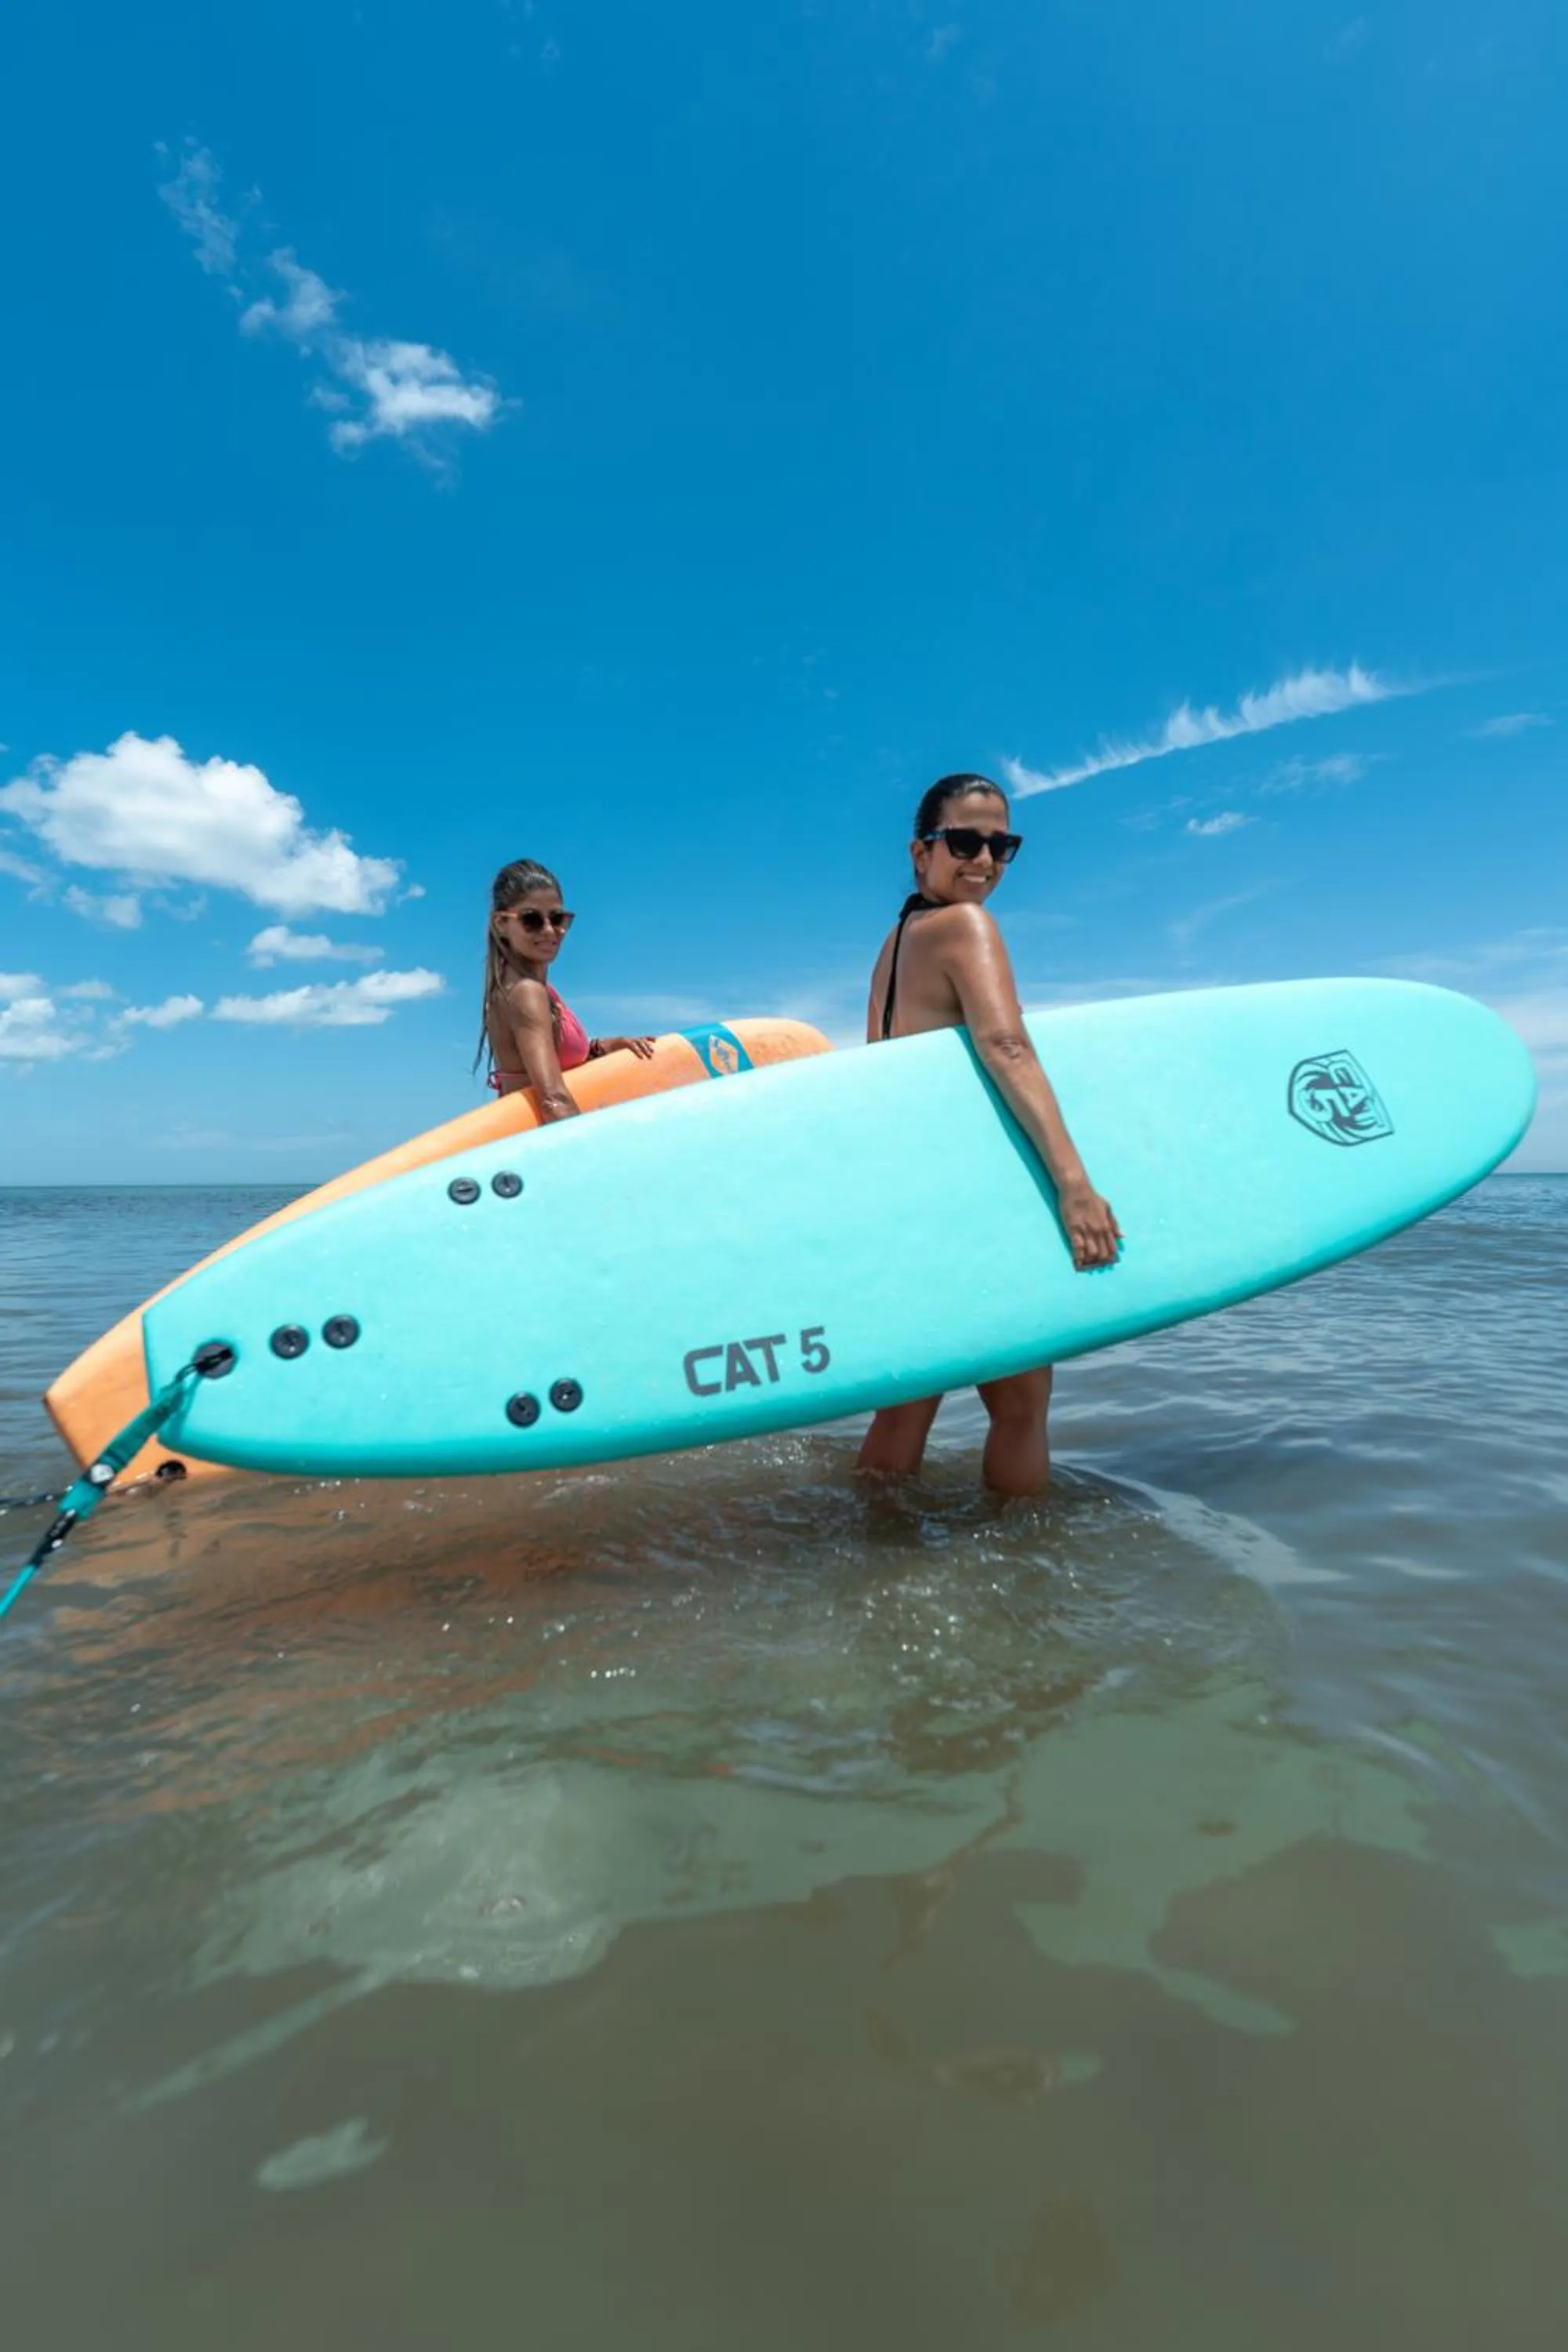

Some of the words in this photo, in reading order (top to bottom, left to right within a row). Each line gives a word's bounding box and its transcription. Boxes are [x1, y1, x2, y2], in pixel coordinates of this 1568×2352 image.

[1301, 1088, 1352, 1123] 5
[683, 1333, 786, 1396] CAT
[800, 1326, 831, 1374] 5
